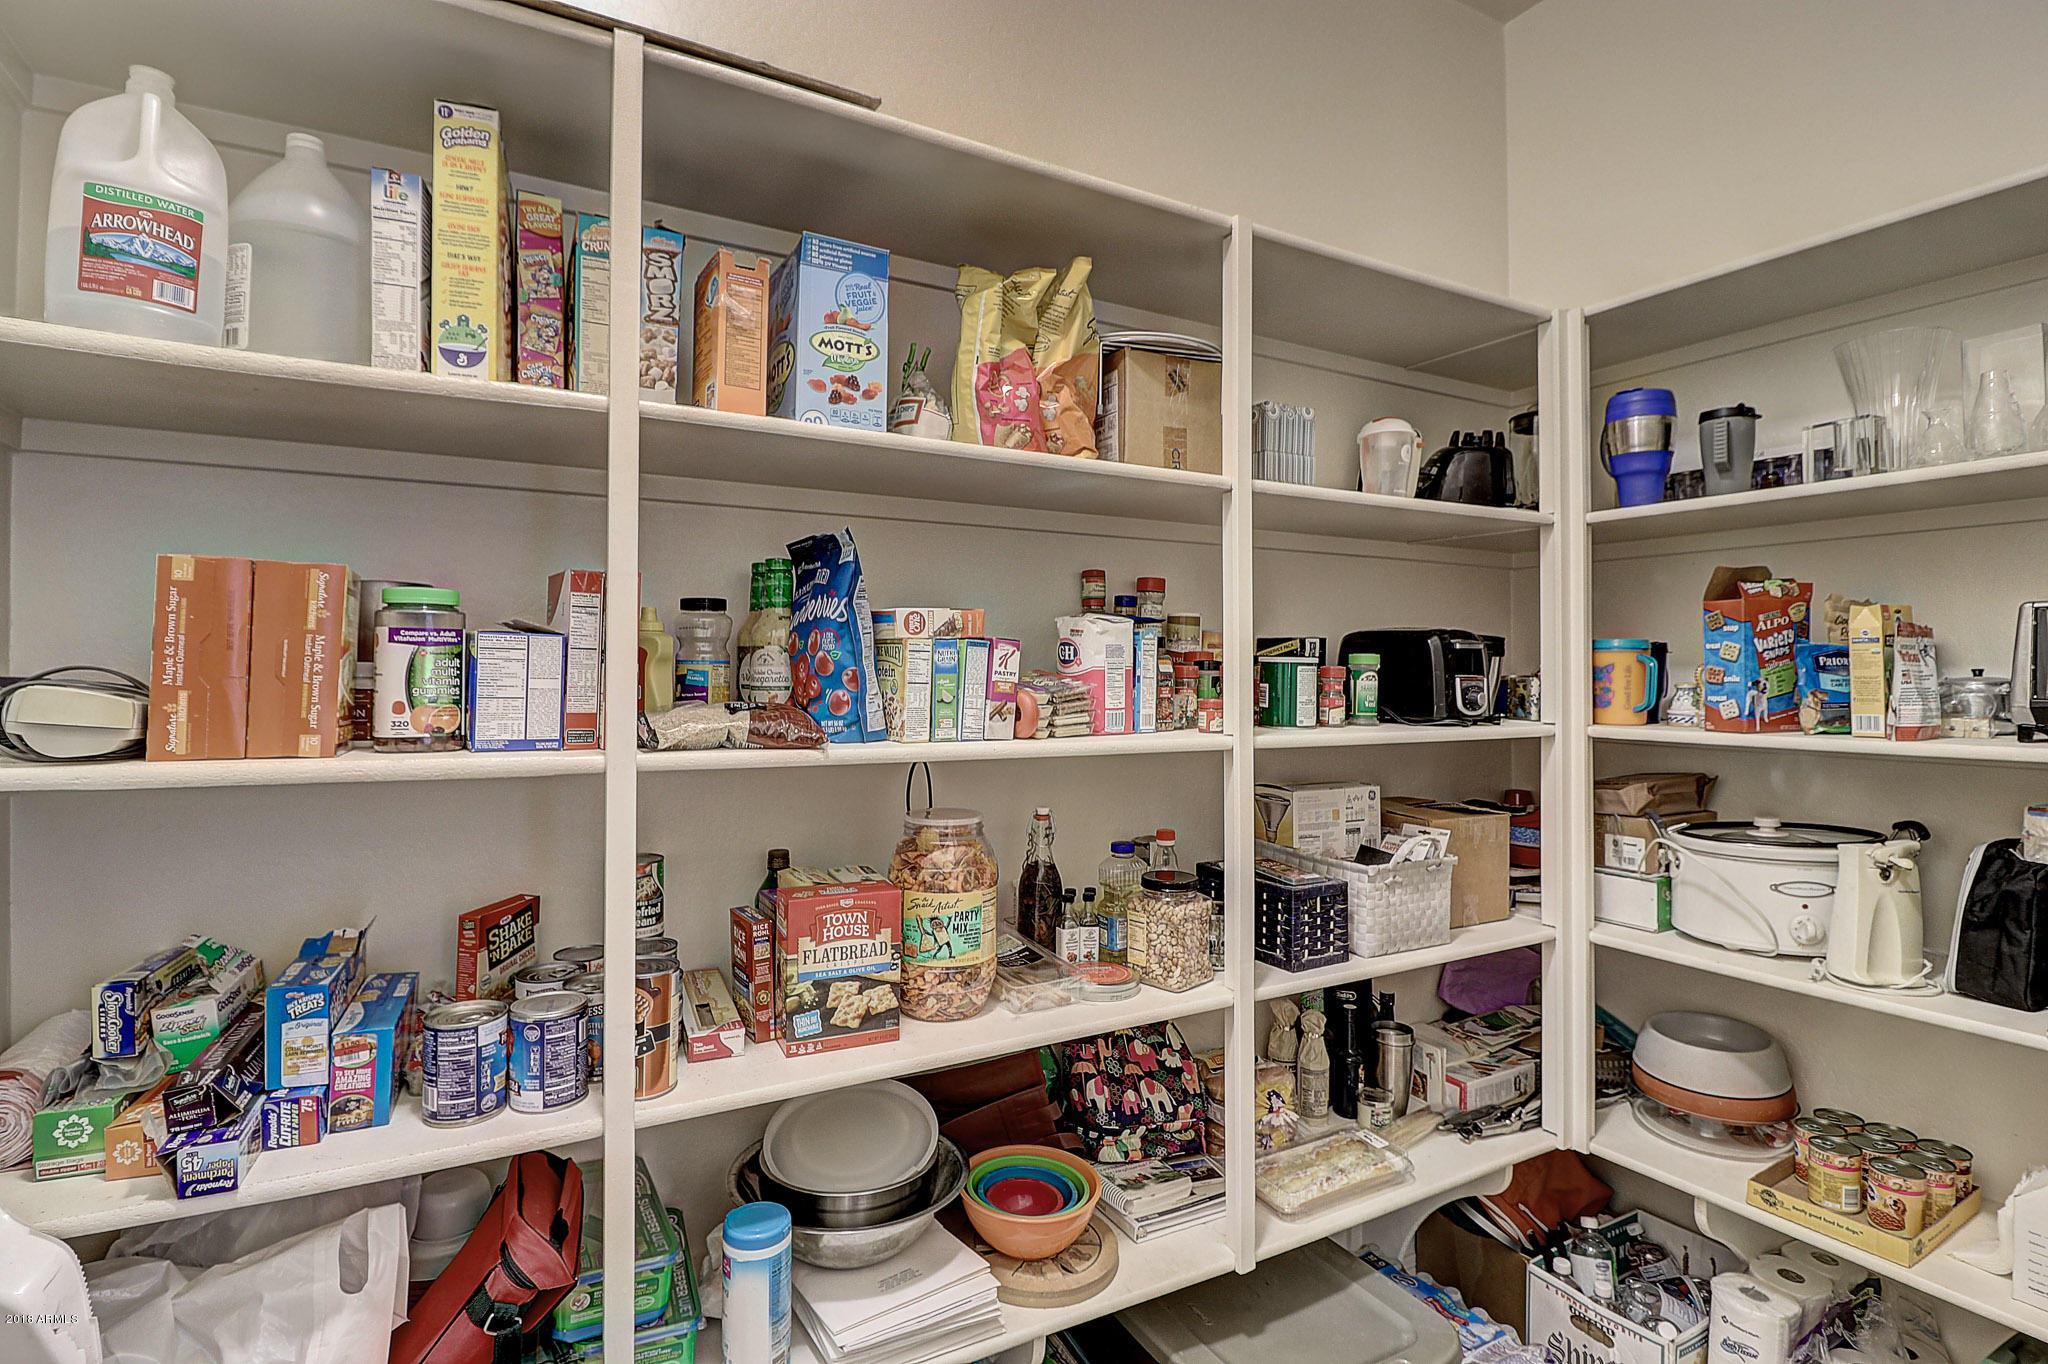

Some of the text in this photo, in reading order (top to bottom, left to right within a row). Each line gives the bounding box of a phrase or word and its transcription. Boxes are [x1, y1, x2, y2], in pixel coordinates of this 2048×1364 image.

[440, 126, 490, 142] Golden
[442, 138, 489, 149] Grahams
[383, 184, 409, 201] Life
[94, 184, 195, 218] DISTILLED WATER
[91, 212, 195, 251] ARROWHEAD
[844, 298, 877, 307] VEGGIE
[846, 290, 872, 300] FRUIT
[817, 336, 873, 357] MOTT'S
[315, 570, 330, 609] Signature
[1755, 615, 1790, 633] ALPO
[161, 586, 180, 686] Maple & Brown Sugar
[175, 634, 186, 686] Instant Oatmeal
[302, 633, 314, 684] Instant Oatmeal
[435, 658, 460, 667] adult
[998, 649, 1016, 670] K
[431, 668, 460, 676] multi-
[994, 670, 1017, 678] PASTRY
[307, 634, 327, 729] Maple & Brown Sugar
[422, 677, 460, 686] vitamin
[412, 686, 460, 697] gummies
[165, 711, 178, 753] Signature
[390, 720, 409, 728] 320
[907, 897, 960, 914] Snack Artist
[822, 911, 868, 926] TOWN
[953, 910, 980, 922] PARTY
[488, 911, 533, 951] SHAKE
[752, 923, 769, 931] RICE
[823, 924, 870, 941] HOUSE
[952, 922, 968, 935] MIX
[489, 926, 533, 963] 'N BAKE
[802, 941, 888, 966] FLATBREAD
[827, 969, 843, 977] SALT
[848, 966, 866, 975] OLIVE
[286, 1001, 298, 1013] RICE
[287, 999, 326, 1020] TREATS
[105, 991, 124, 1054] Slow Cooker
[294, 1020, 323, 1030] Original
[334, 1073, 371, 1085] AMAZING
[334, 1081, 371, 1092] CREATIONS
[168, 1107, 211, 1120] ALUMINUM
[181, 1113, 198, 1122] FOIL
[291, 1103, 300, 1130] PAPER
[267, 1111, 279, 1149] Reynolds
[278, 1101, 292, 1147] CUT-RITE
[181, 1156, 204, 1173] 45
[206, 1159, 235, 1170] Paper
[181, 1167, 234, 1183] Parchment
[193, 1178, 235, 1193] Reynolds
[1808, 1209, 1822, 1221] good
[1822, 1214, 1836, 1225] food
[651, 1231, 669, 1252] WET
[679, 1298, 694, 1318] WET
[1555, 1289, 1590, 1314] SUMMER
[1593, 1312, 1645, 1344] FAVORITE
[1720, 1336, 1738, 1352] Bath
